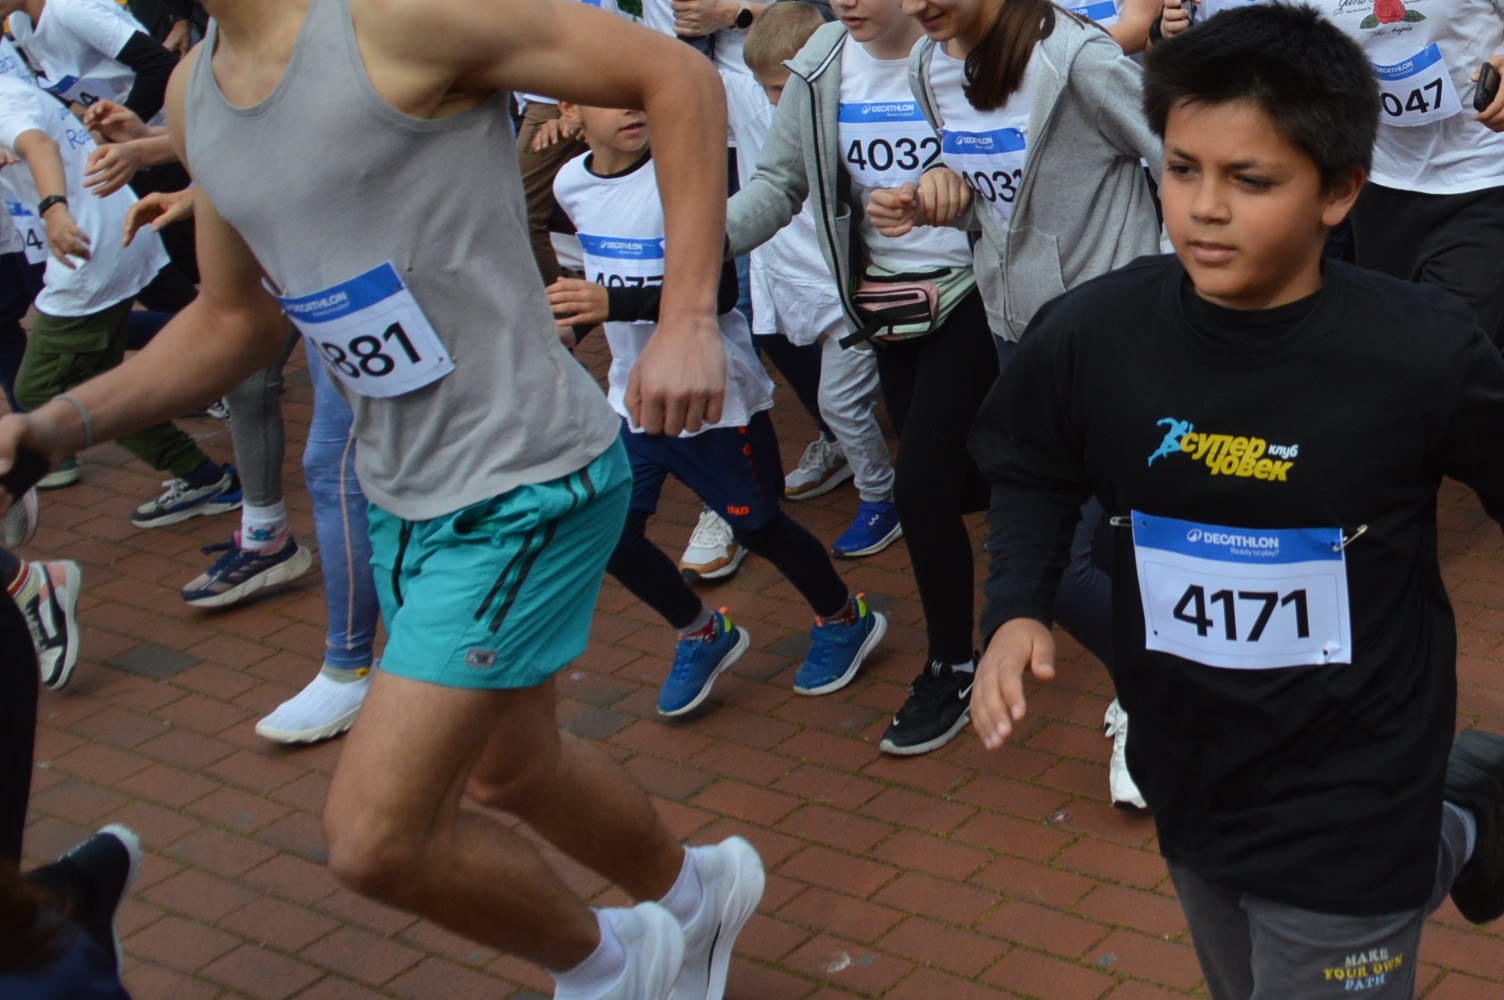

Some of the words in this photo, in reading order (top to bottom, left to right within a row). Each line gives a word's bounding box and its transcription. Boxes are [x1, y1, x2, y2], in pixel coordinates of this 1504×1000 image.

[871, 104, 915, 113] DECATHLON
[847, 137, 942, 171] 4032
[1268, 445, 1298, 459] клуб
[1205, 452, 1293, 481] човек
[1204, 532, 1279, 549] DECATHLON
[1230, 547, 1252, 557] Ready
[1173, 584, 1310, 642] 4171
[1323, 966, 1369, 980] YOUR
[1372, 954, 1404, 974] OWN
[1344, 949, 1389, 968] MAKE
[1344, 973, 1386, 990] PATH
